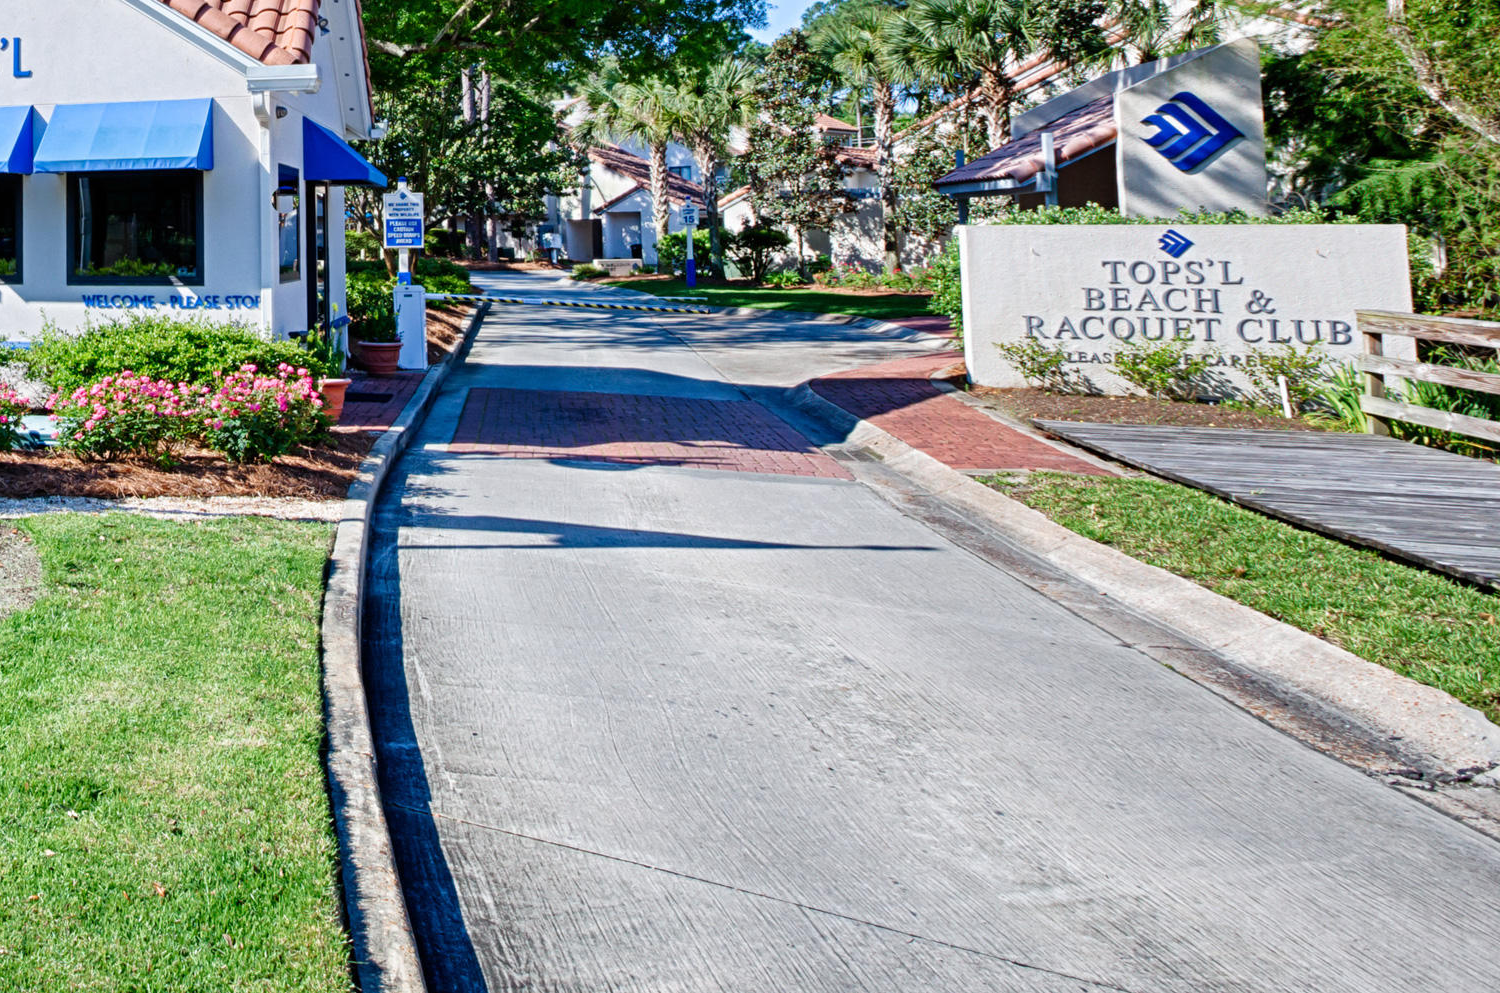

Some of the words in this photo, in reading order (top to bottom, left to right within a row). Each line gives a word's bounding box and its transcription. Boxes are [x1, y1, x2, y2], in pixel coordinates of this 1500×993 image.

[683, 215, 694, 224] 15
[1101, 259, 1244, 286] TOPS'L
[82, 294, 157, 310] WELCOME
[169, 294, 220, 310] PLEASE
[1081, 287, 1223, 314] BEACH
[1244, 289, 1276, 315] &
[1022, 315, 1221, 345] RACQUET
[1236, 318, 1353, 346] CLUB
